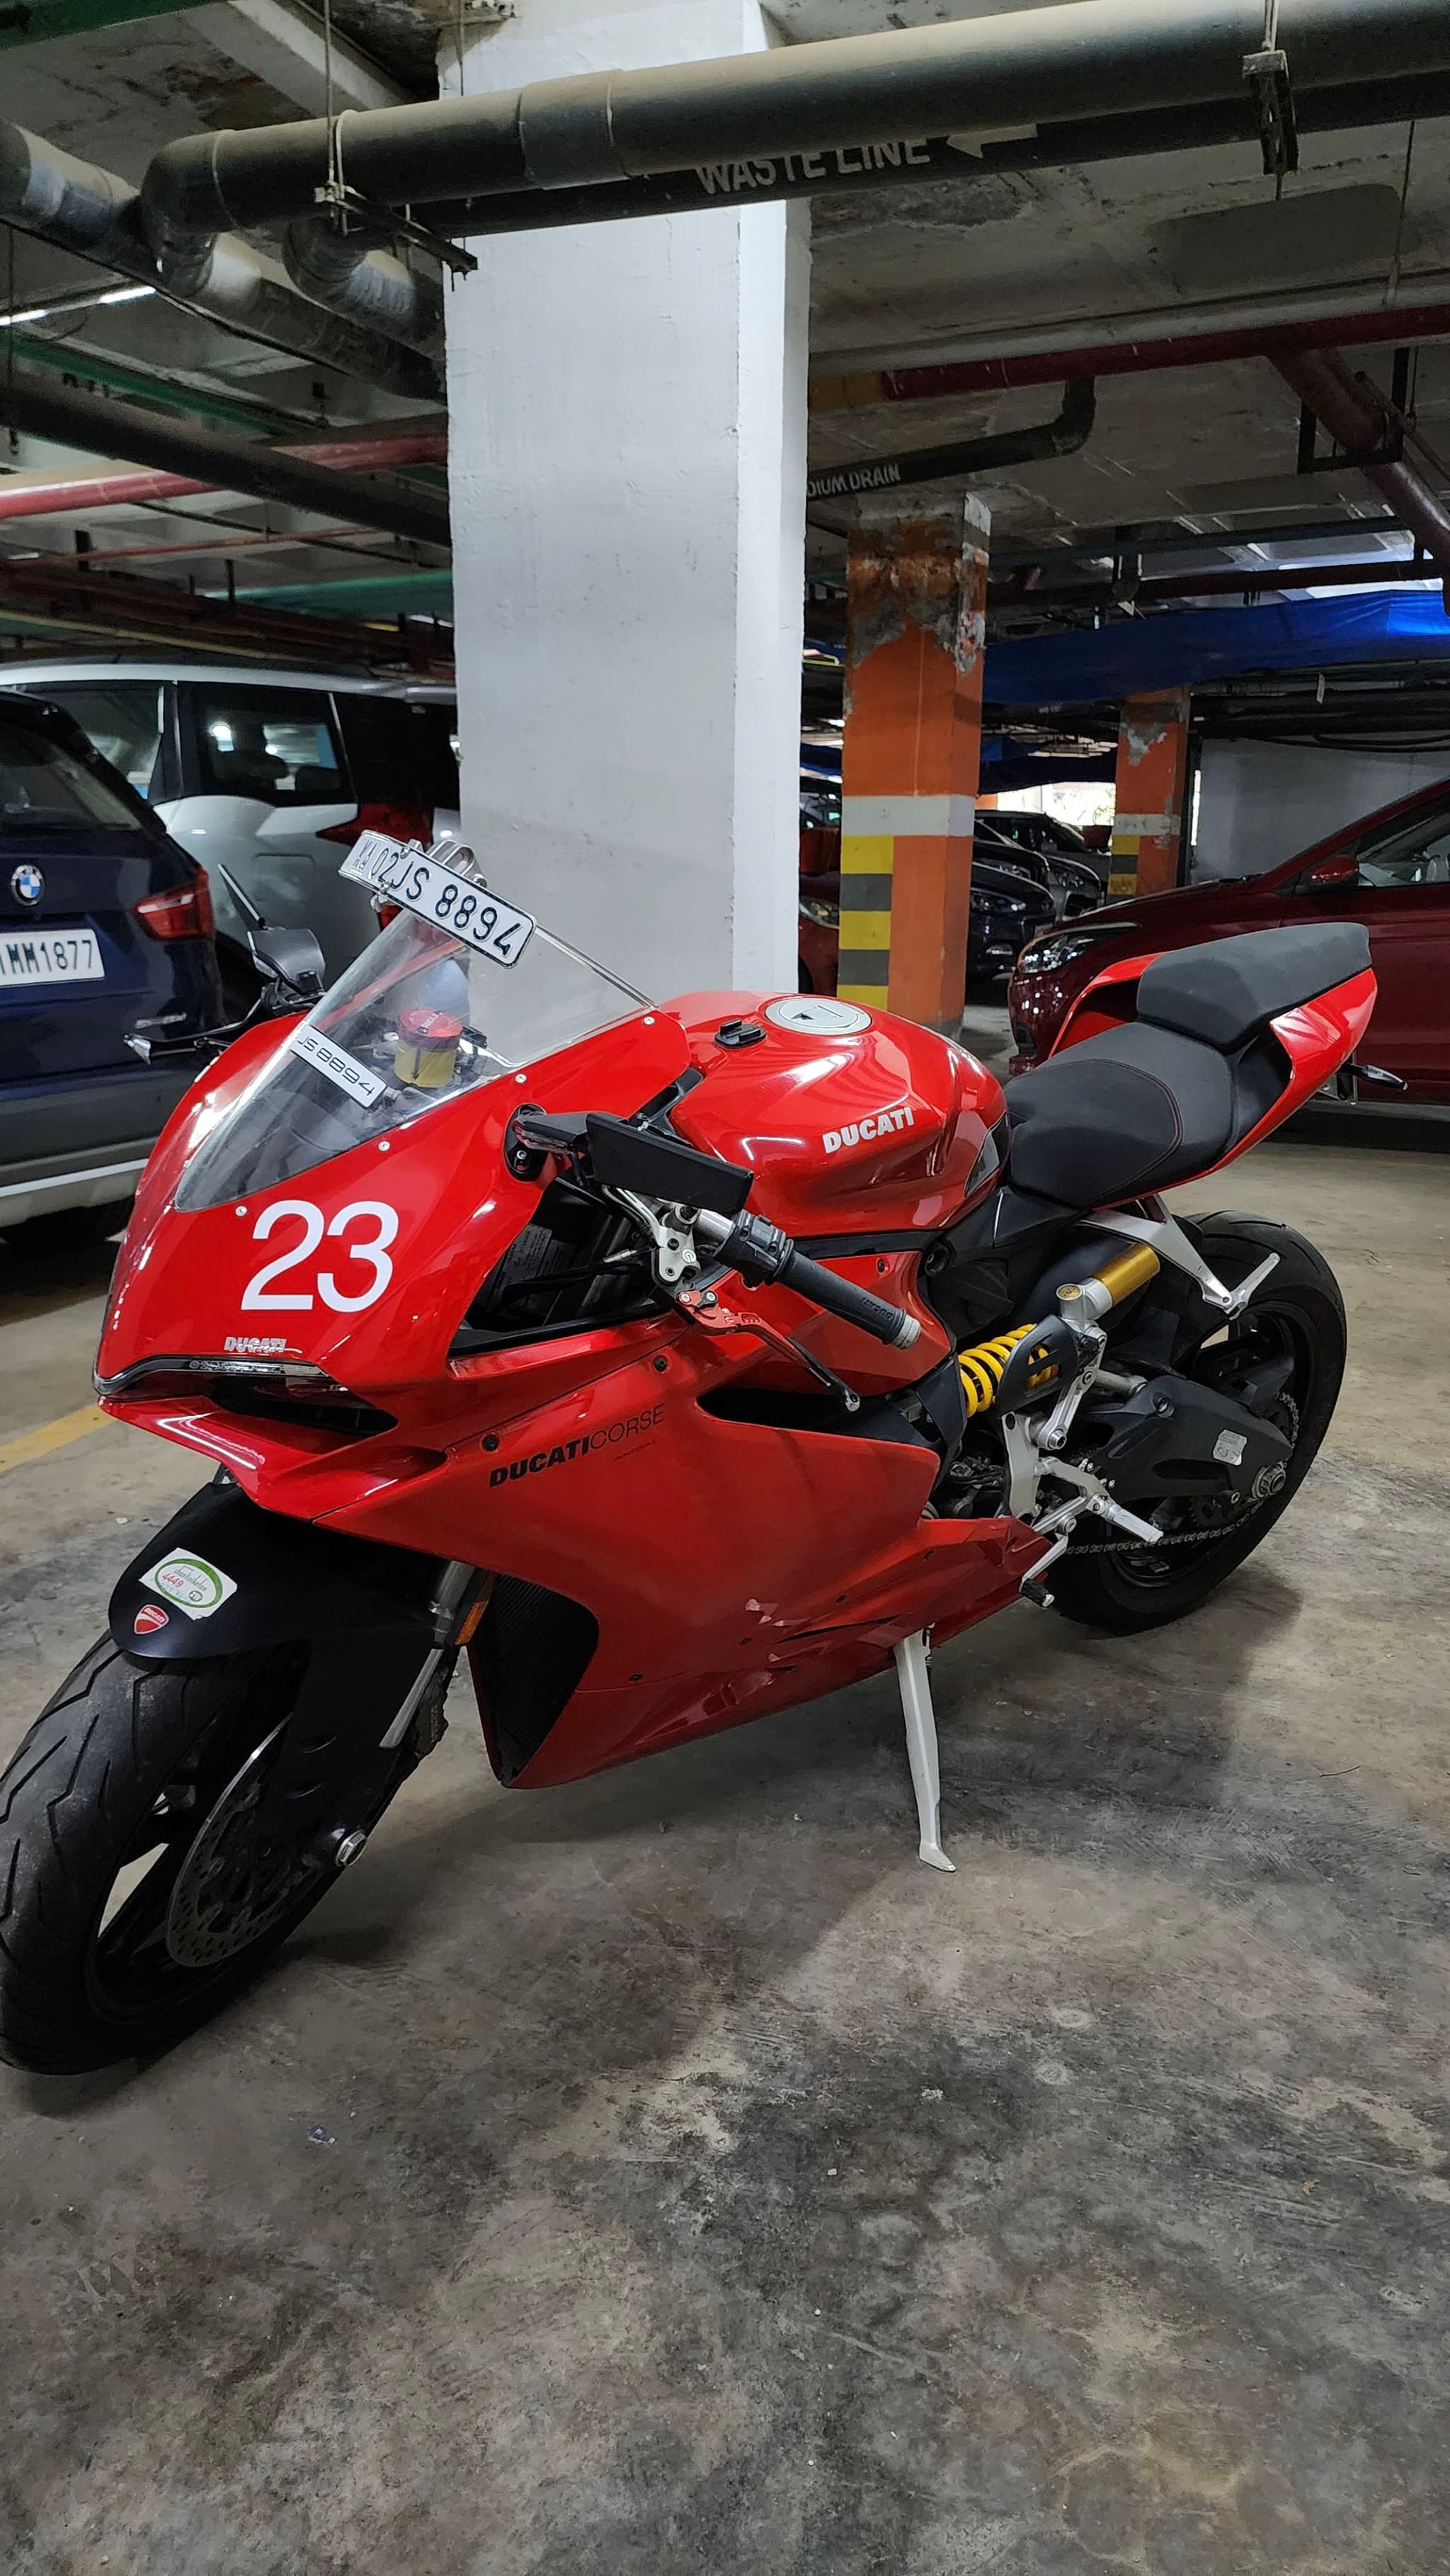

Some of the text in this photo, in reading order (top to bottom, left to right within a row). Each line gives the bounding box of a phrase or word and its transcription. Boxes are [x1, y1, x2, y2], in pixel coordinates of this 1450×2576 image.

[695, 141, 931, 195] WASTE LINE
[850, 463, 901, 490] DRAIN
[435, 884, 521, 956] 8894
[822, 1107, 915, 1154] DUCATI
[241, 1199, 399, 1313] 23
[224, 1336, 287, 1354] DUCATI
[162, 1573, 184, 1588] 4449
